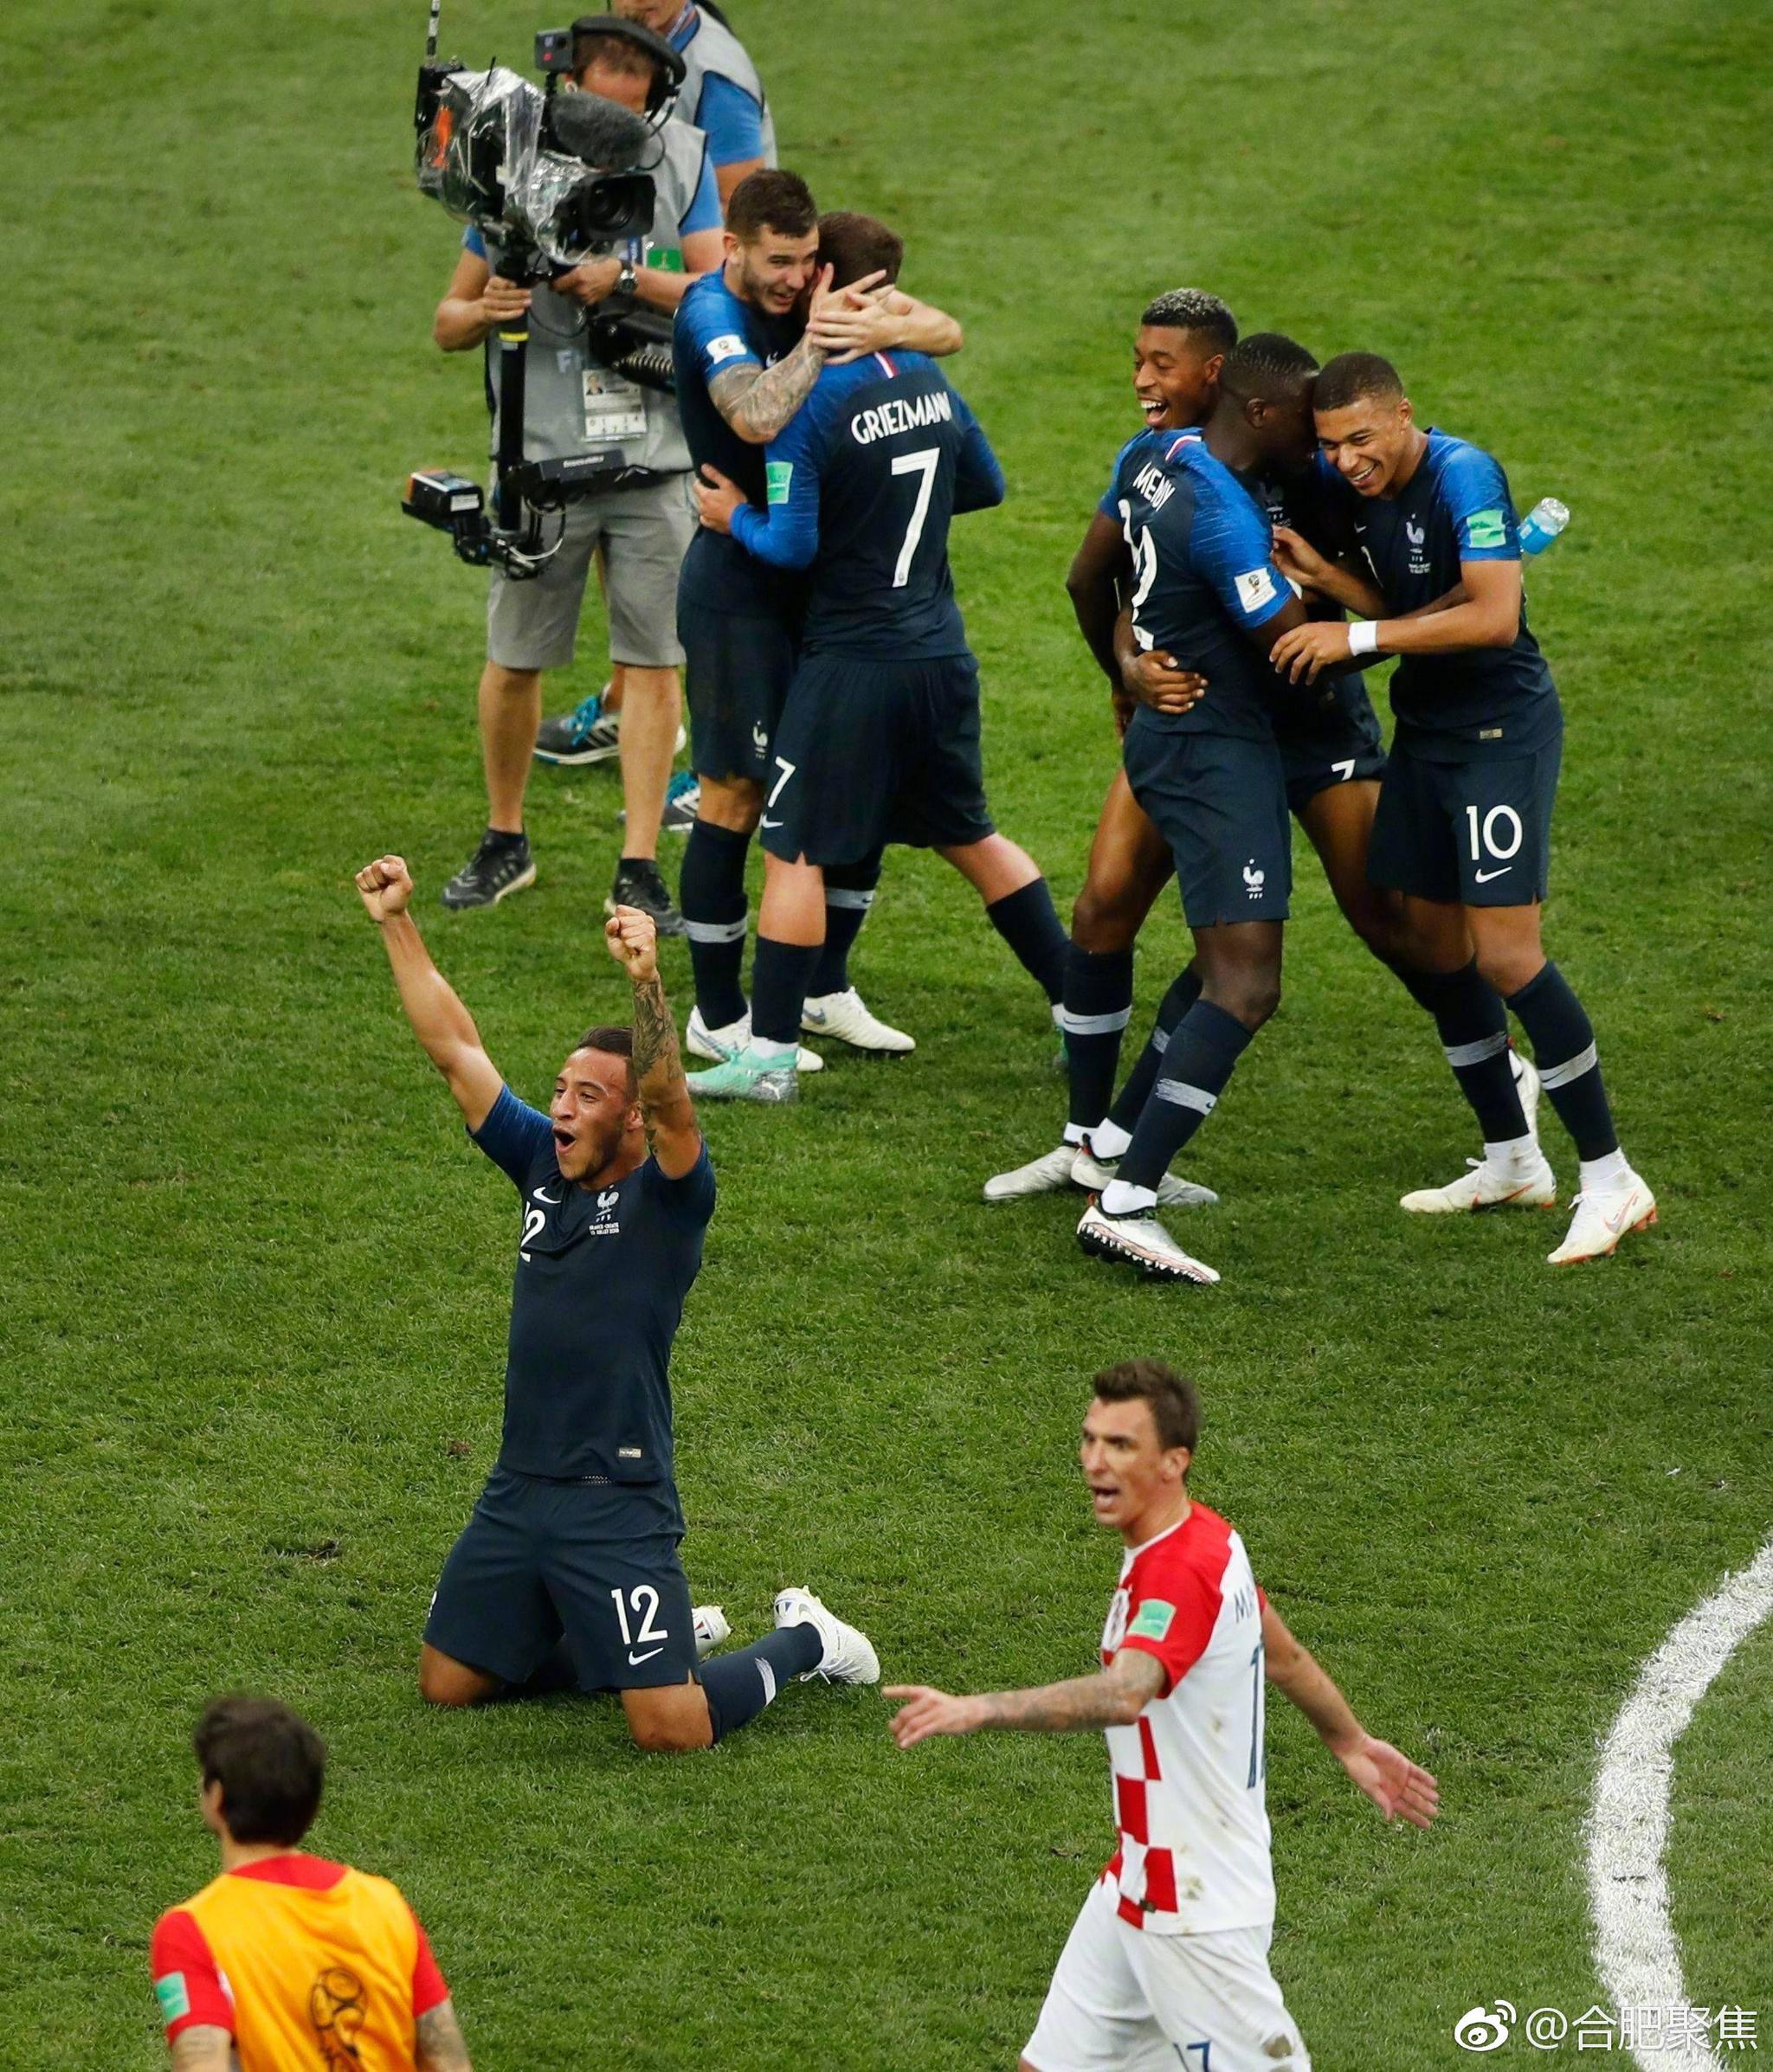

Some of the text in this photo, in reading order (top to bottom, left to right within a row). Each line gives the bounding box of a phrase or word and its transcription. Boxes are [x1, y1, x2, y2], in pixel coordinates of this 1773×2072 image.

[851, 391, 952, 445] GRIEZMANN
[1131, 460, 1176, 512] MENDY
[891, 447, 940, 589] 7
[767, 755, 796, 808] 7
[1466, 804, 1523, 860] 10
[610, 1584, 668, 1645] 12
